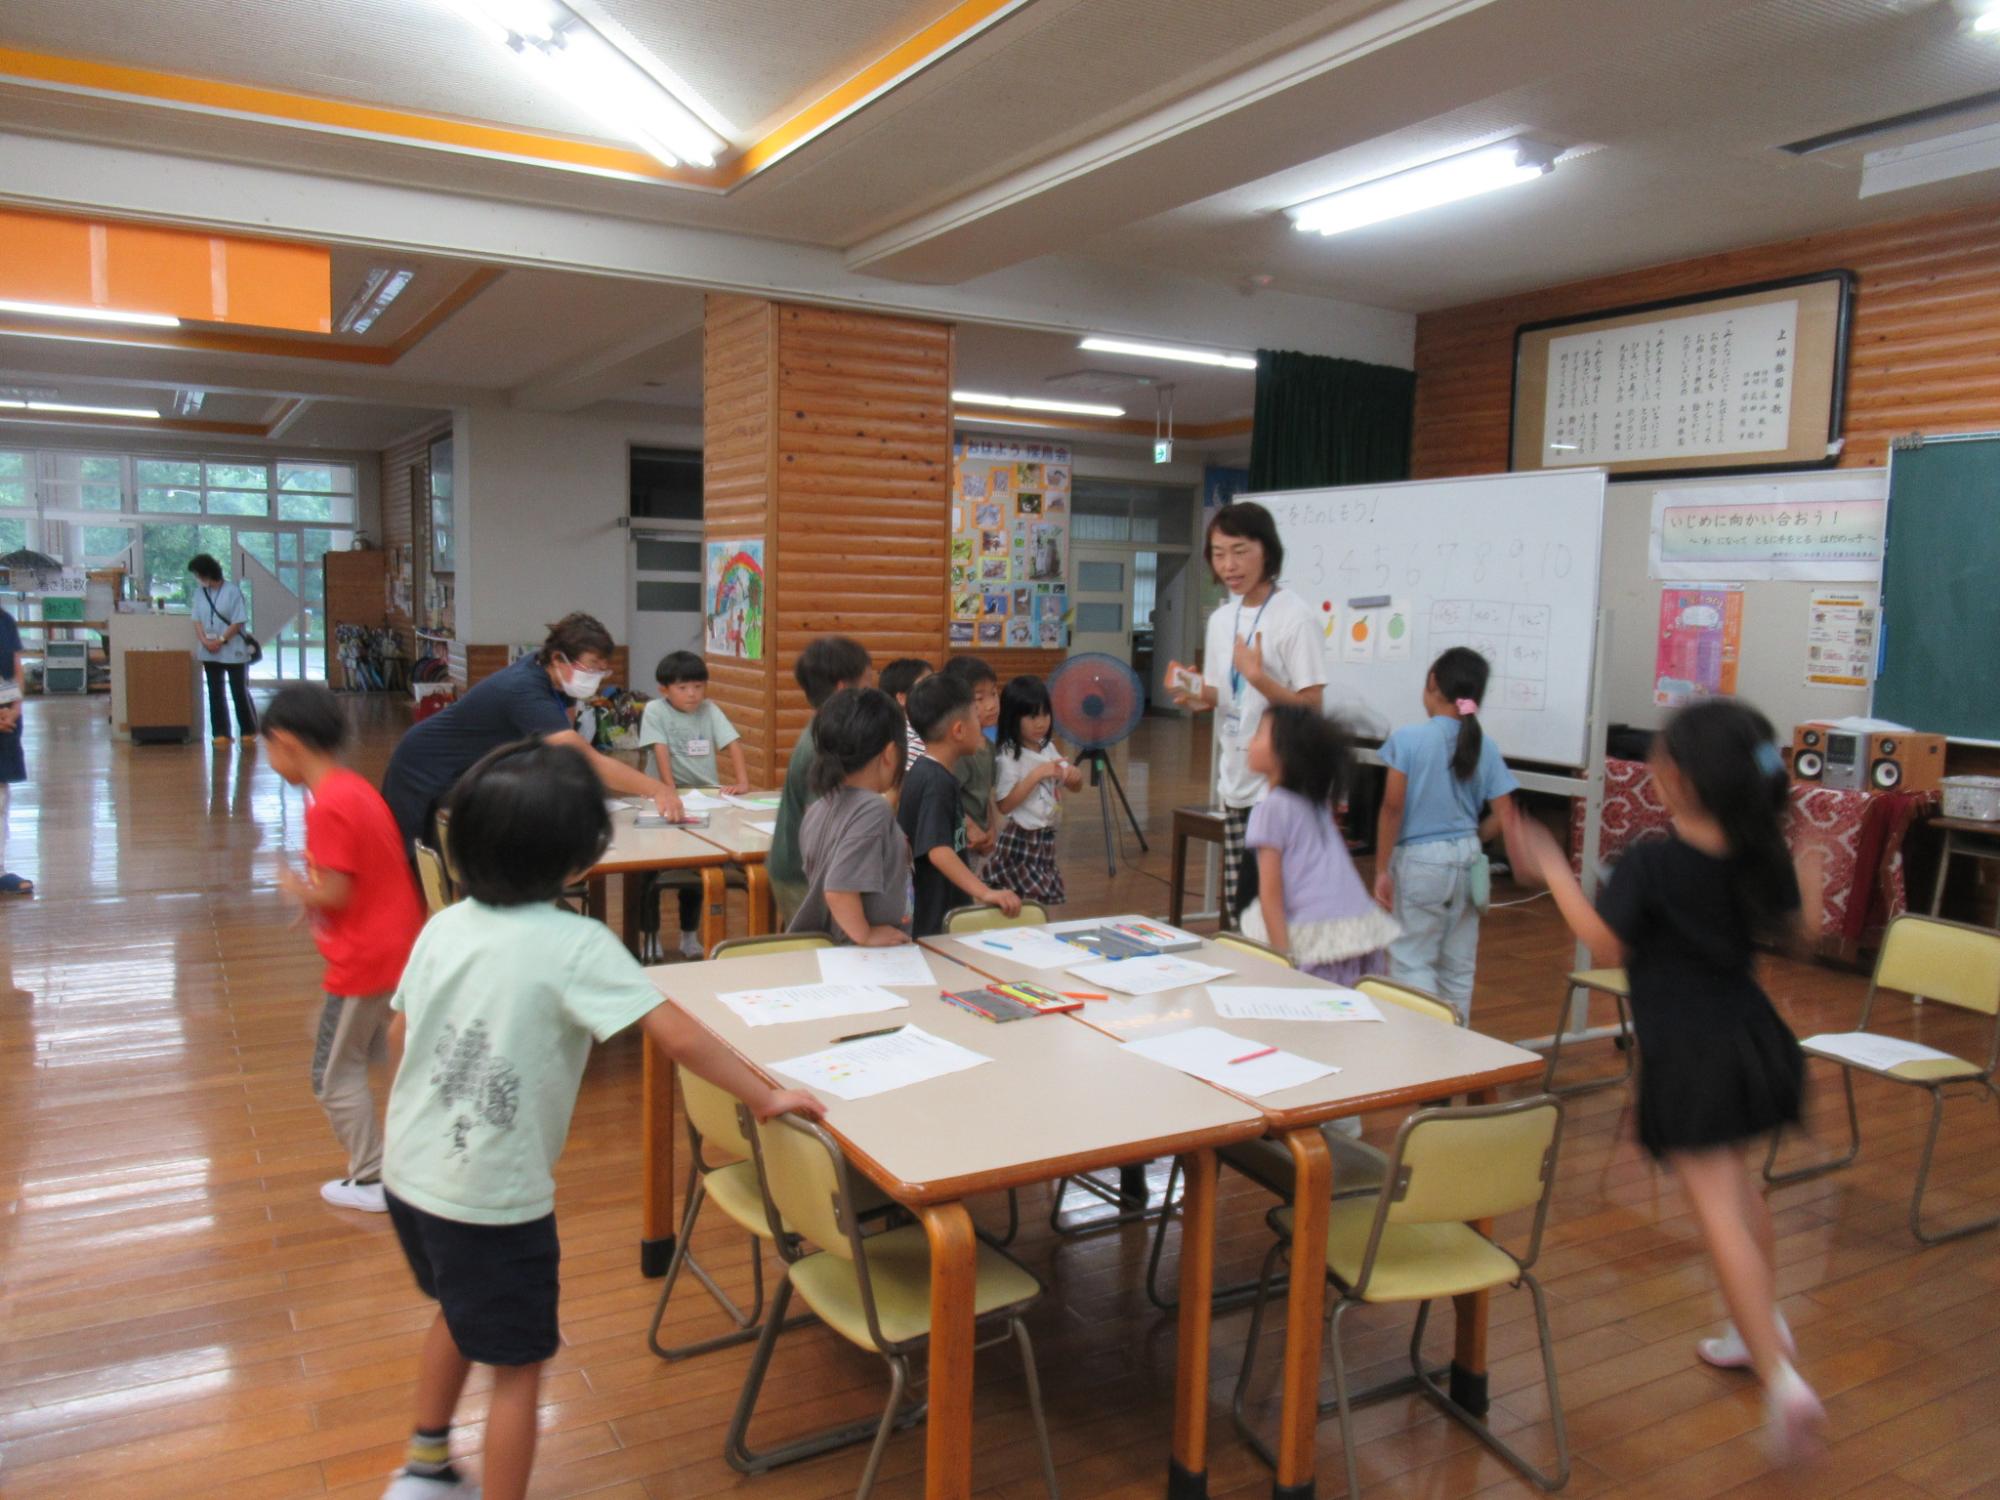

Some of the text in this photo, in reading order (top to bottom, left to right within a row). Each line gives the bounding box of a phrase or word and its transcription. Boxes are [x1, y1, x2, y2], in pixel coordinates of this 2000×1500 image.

[969, 440, 1020, 457] おはよう
[1671, 511, 1838, 529] いじめに向かい合おう！
[1311, 544, 1326, 586] 3
[1337, 547, 1361, 585] 4
[1373, 545, 1391, 588] 5
[1405, 542, 1422, 587] 6
[1437, 543, 1458, 593] 7
[1472, 541, 1492, 583] 8
[1507, 537, 1525, 581] 9
[1540, 540, 1574, 579] 10
